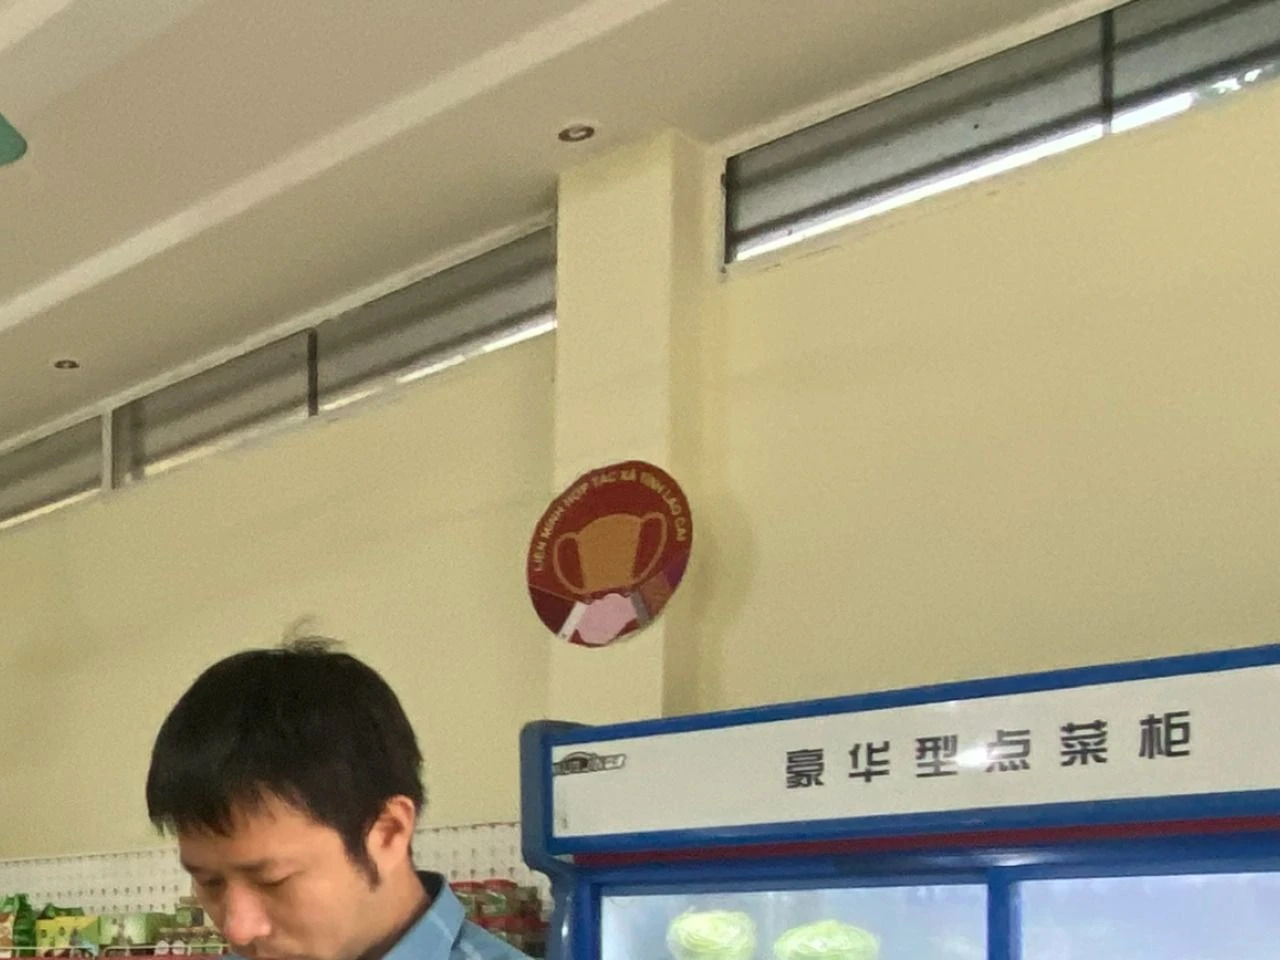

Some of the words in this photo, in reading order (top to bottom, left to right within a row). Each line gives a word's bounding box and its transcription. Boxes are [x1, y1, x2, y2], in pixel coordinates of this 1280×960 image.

[786, 711, 1191, 789] 豪华型点菜柜
